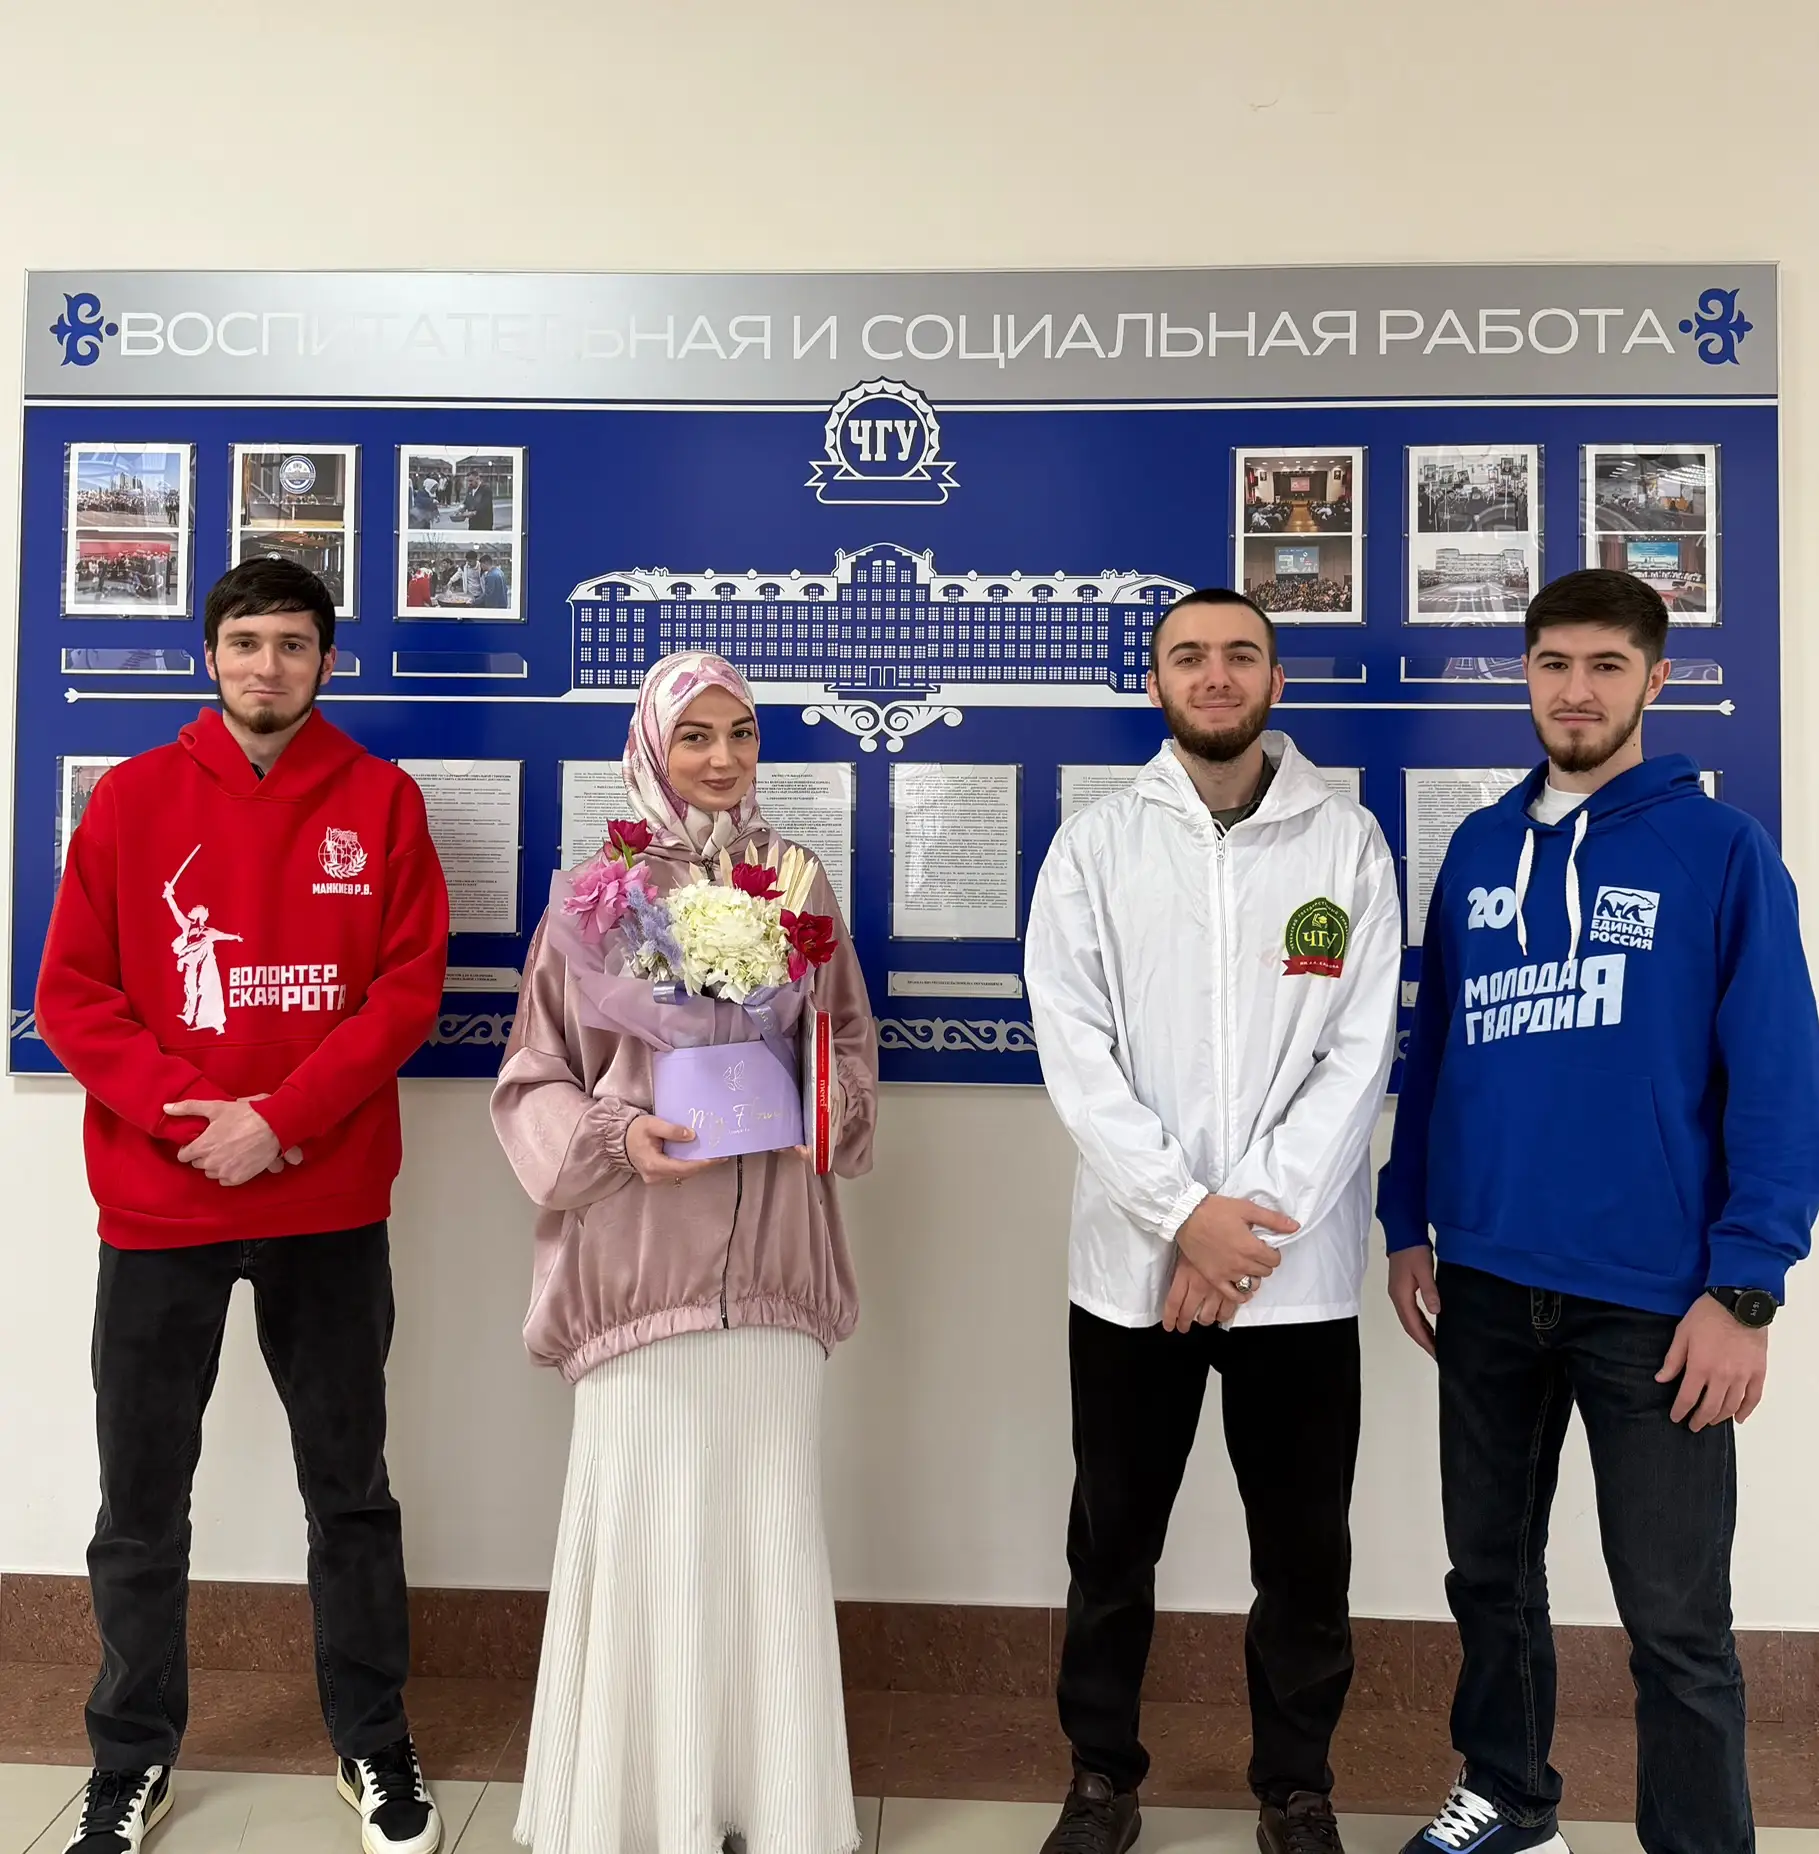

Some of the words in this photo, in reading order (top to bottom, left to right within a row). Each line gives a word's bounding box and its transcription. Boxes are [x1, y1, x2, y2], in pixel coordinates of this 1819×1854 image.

[793, 315, 837, 359] И
[861, 311, 1357, 369] СОЦИАЛЬНАЯ
[1379, 308, 1676, 355] РАБОТА
[848, 419, 918, 461] ЧГУ
[1467, 886, 1517, 930] 20
[1302, 930, 1338, 949] ЧГУ
[1589, 930, 1653, 951] РОССИЯ
[1591, 919, 1654, 938] ЕДИНАЯ
[229, 964, 338, 987] ВОЛОНТЕР
[229, 986, 280, 1008] СКАЯ
[281, 984, 346, 1012] РОТА
